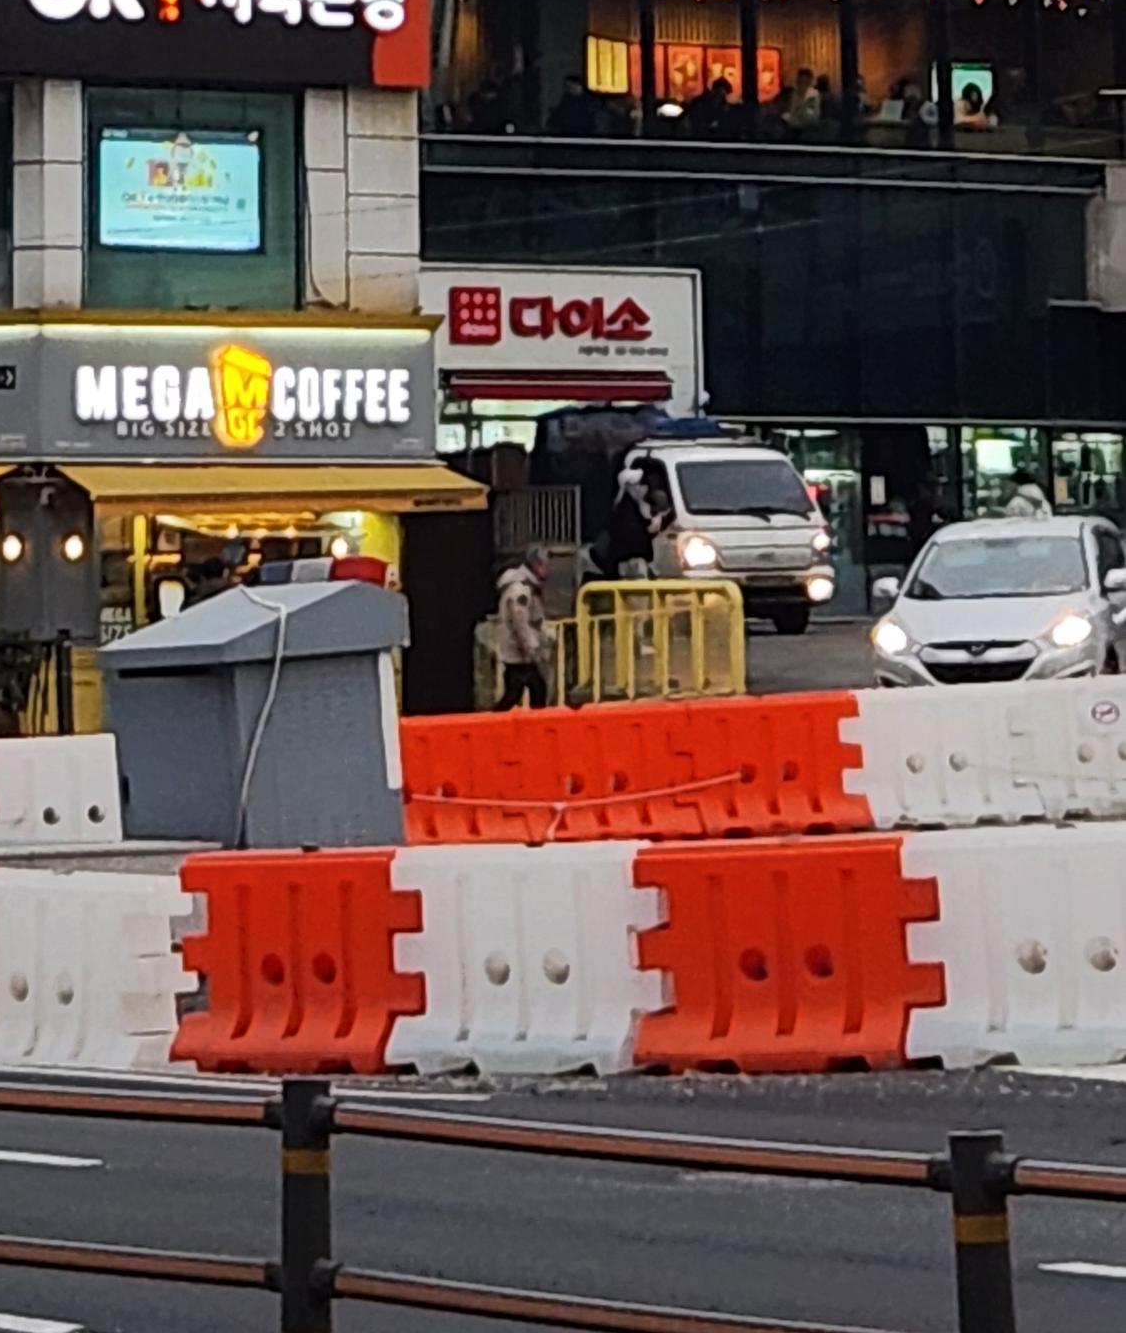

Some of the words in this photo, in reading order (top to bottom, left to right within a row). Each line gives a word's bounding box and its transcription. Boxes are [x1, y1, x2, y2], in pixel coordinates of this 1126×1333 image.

[509, 296, 652, 341] 다이소
[75, 365, 215, 421] MEGA
[272, 365, 410, 423] COFFEE
